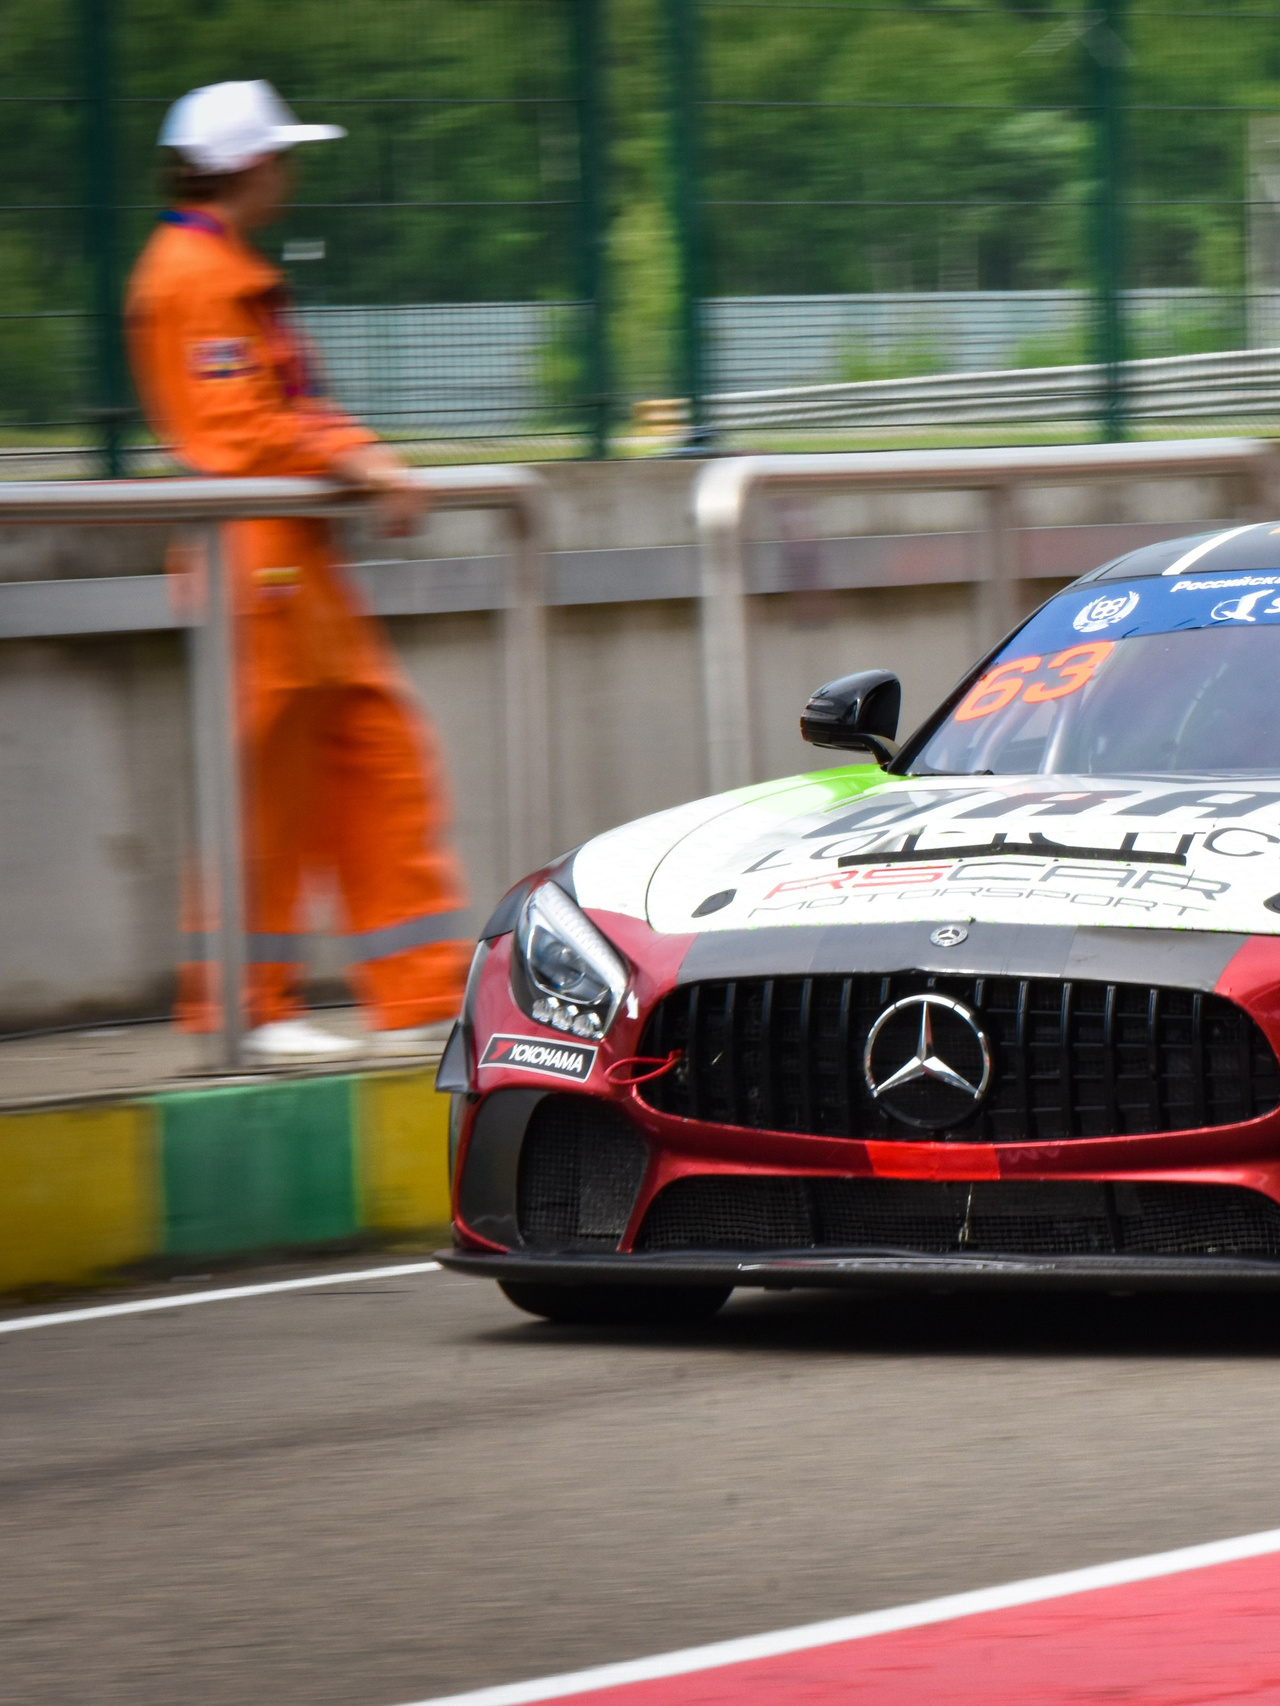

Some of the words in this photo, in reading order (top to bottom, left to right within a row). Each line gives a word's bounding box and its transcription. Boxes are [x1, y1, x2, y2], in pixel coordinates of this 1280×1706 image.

[954, 640, 1115, 723] 63
[763, 861, 1232, 901] RSCAR
[747, 886, 1210, 918] MOTORSPORT
[508, 1043, 585, 1073] YOKOHAMA
